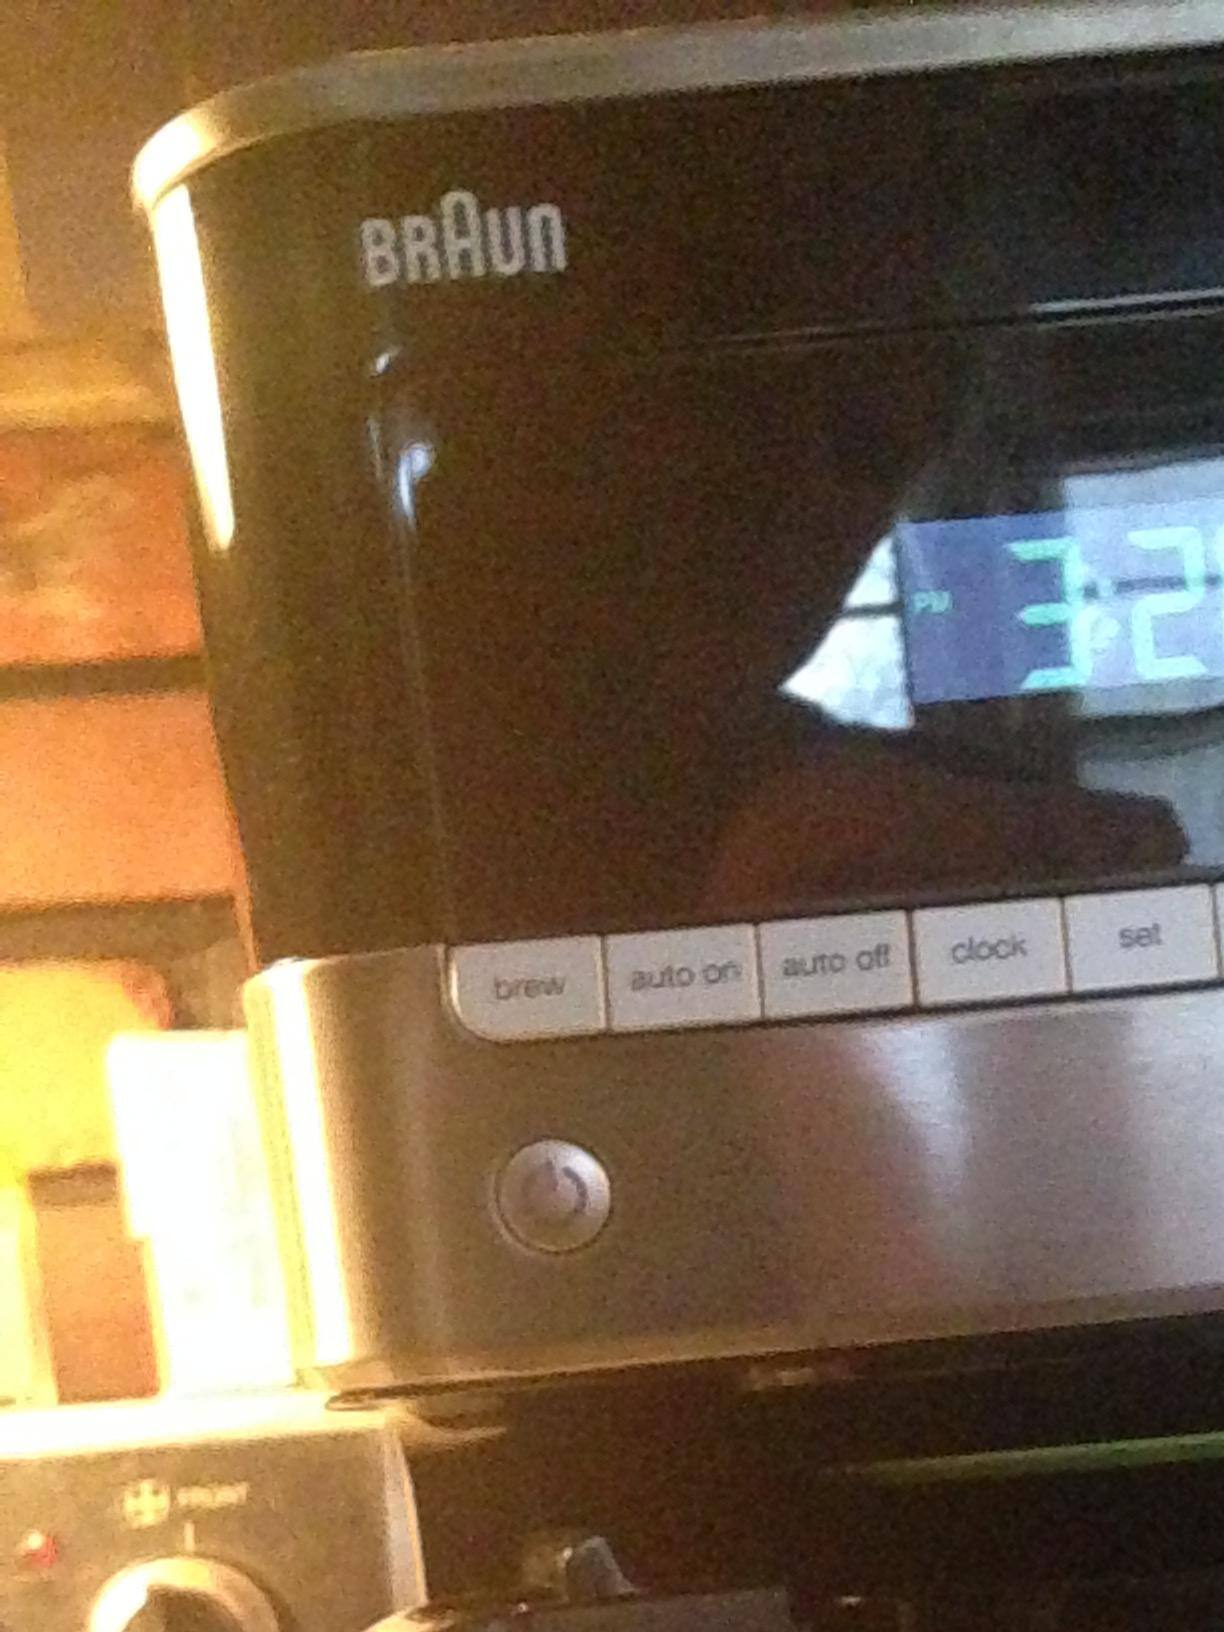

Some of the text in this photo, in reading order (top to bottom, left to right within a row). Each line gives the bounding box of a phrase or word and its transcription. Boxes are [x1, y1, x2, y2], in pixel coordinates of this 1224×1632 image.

[360, 190, 568, 287] BRAUN
[950, 934, 1029, 965] clock
[1118, 921, 1162, 950] set
[630, 959, 743, 992] auto on
[780, 941, 892, 978] auto off
[493, 972, 567, 1001] brew
